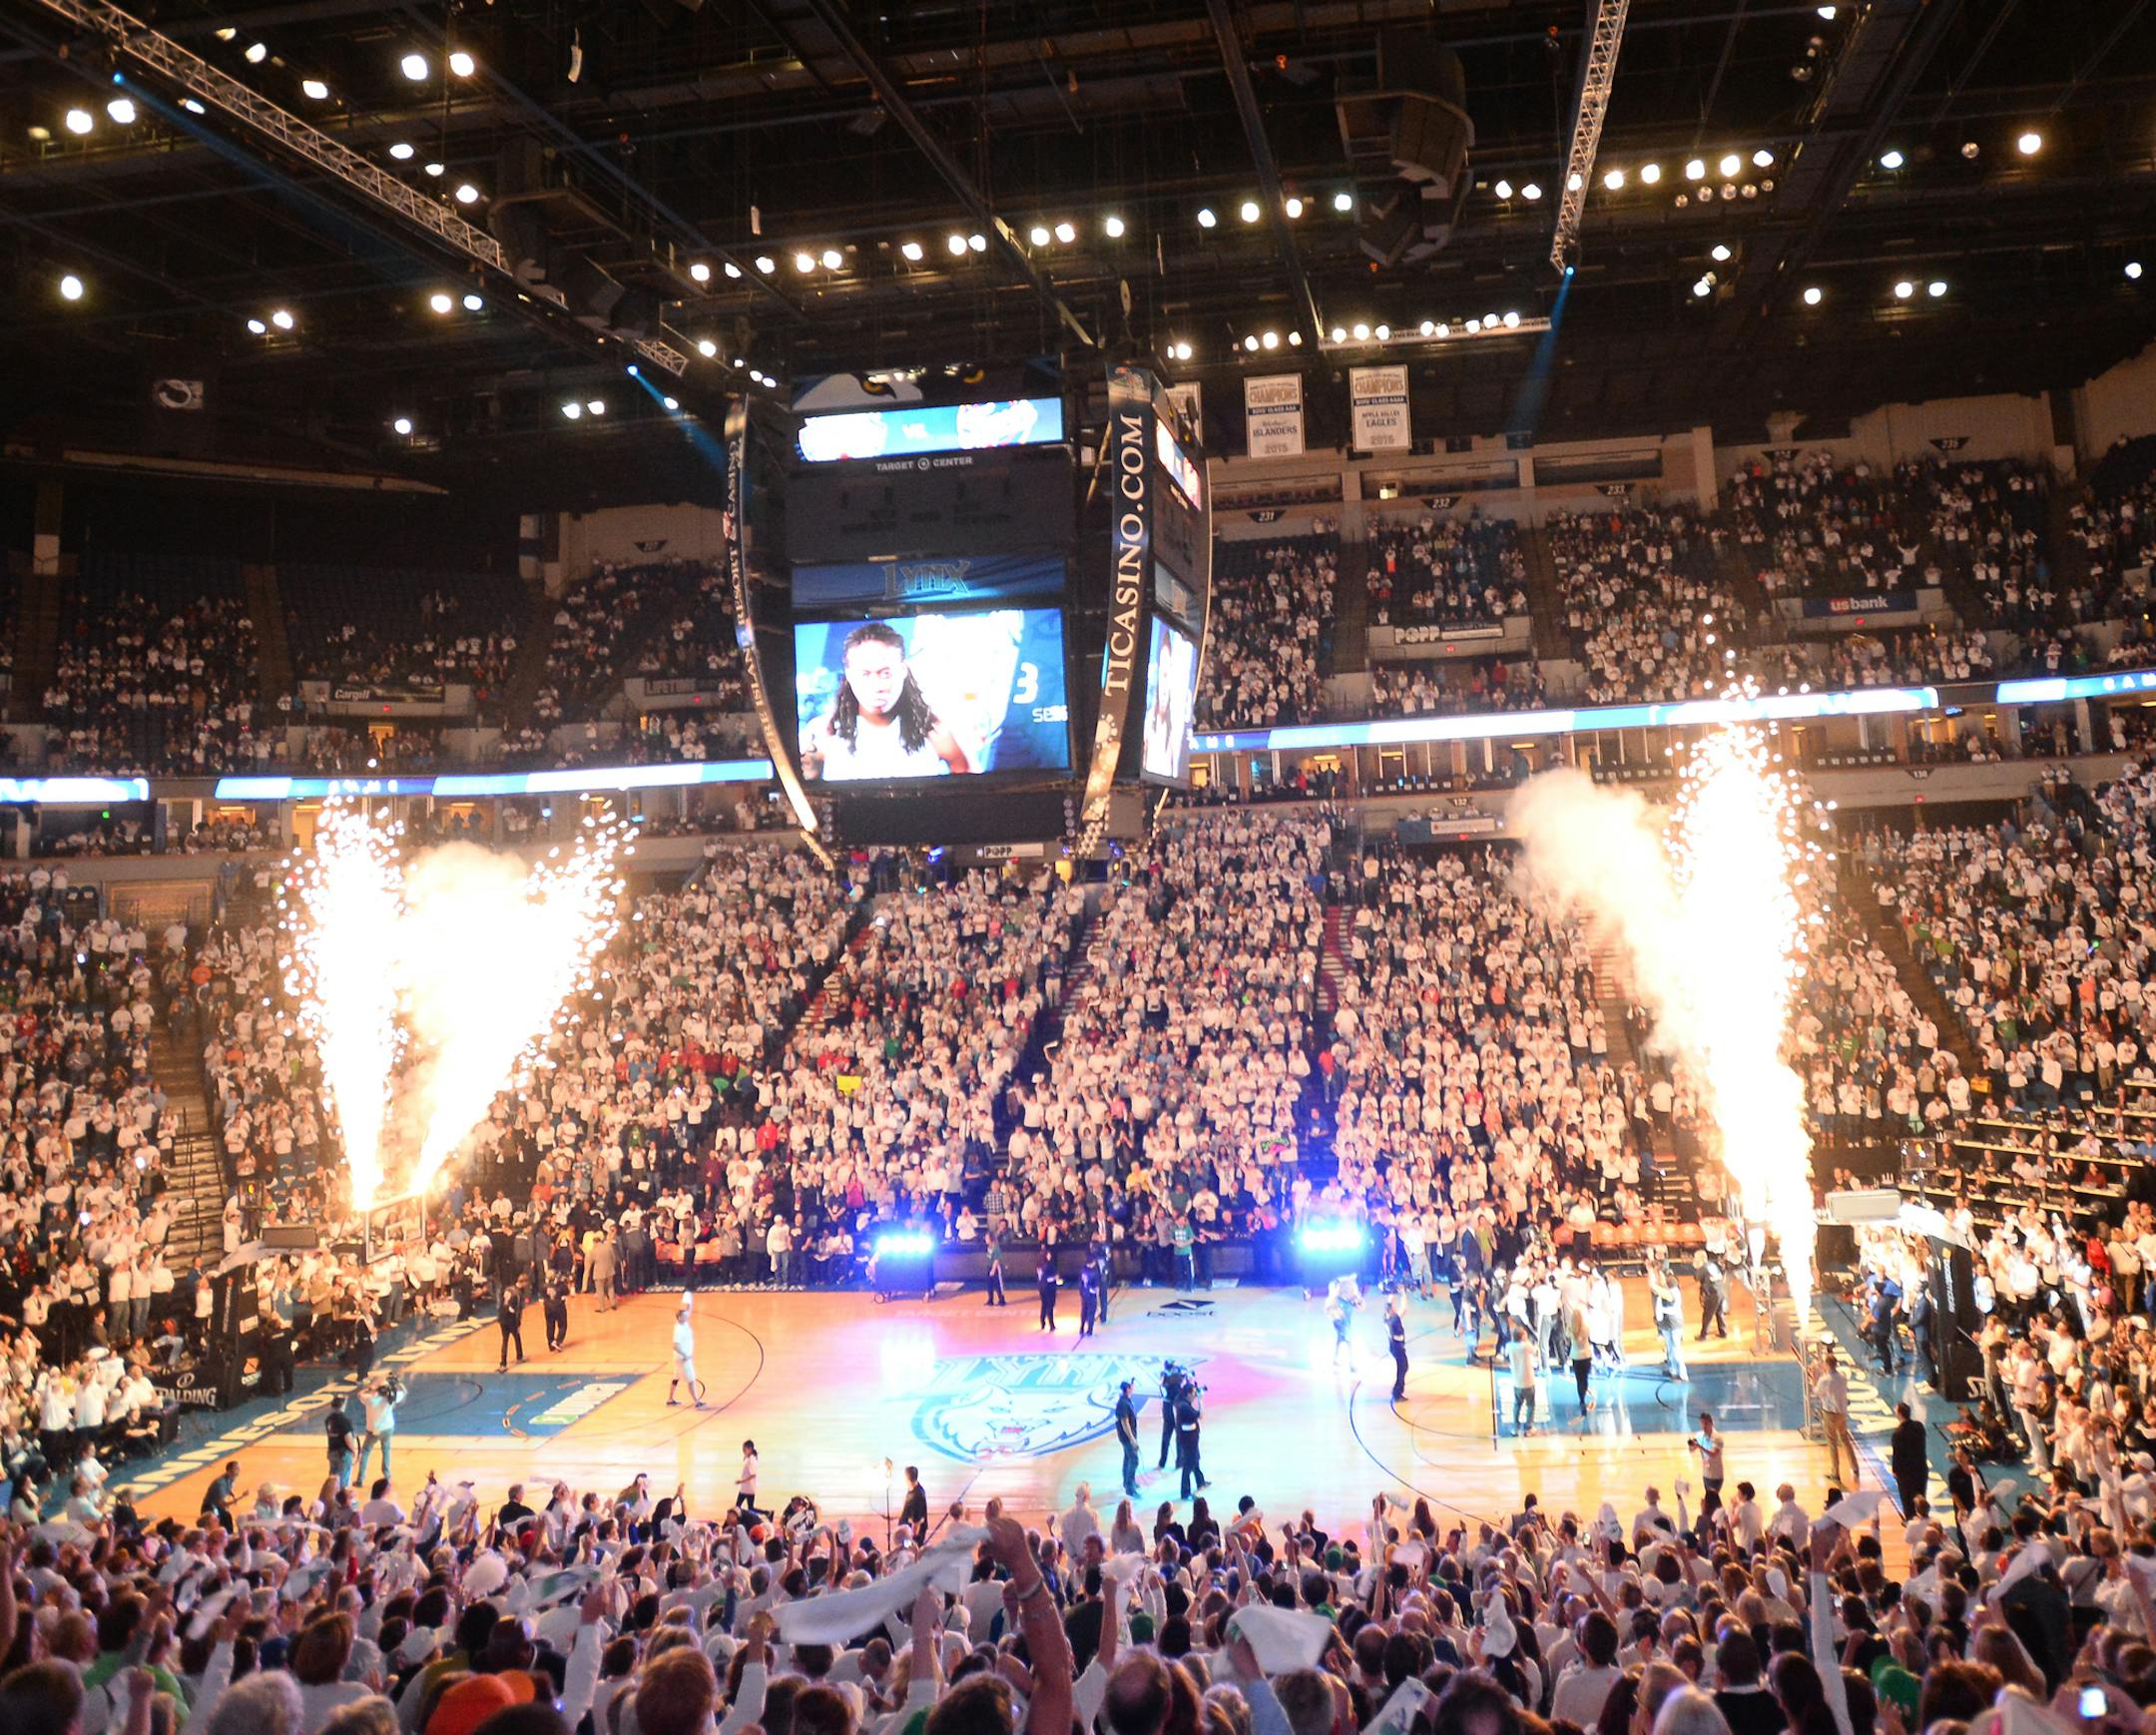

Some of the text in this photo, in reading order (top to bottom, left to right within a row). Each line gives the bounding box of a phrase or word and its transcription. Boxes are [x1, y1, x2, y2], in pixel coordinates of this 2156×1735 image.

[1365, 418, 1397, 428] EAGLES
[1253, 425, 1298, 438] ISLANDERS
[875, 456, 973, 472] TARGET CENTER
[1432, 497, 1450, 509] 232
[1258, 510, 1276, 521] 231
[1105, 412, 1145, 697] TICASINO.COM
[881, 559, 971, 601] LYNX
[1394, 625, 1440, 645] POPP
[1013, 661, 1039, 705] 3
[335, 688, 370, 702] Cargill
[985, 846, 1013, 858] POPP
[383, 1316, 498, 1363] LYNX
[154, 1386, 218, 1408] PALDING
